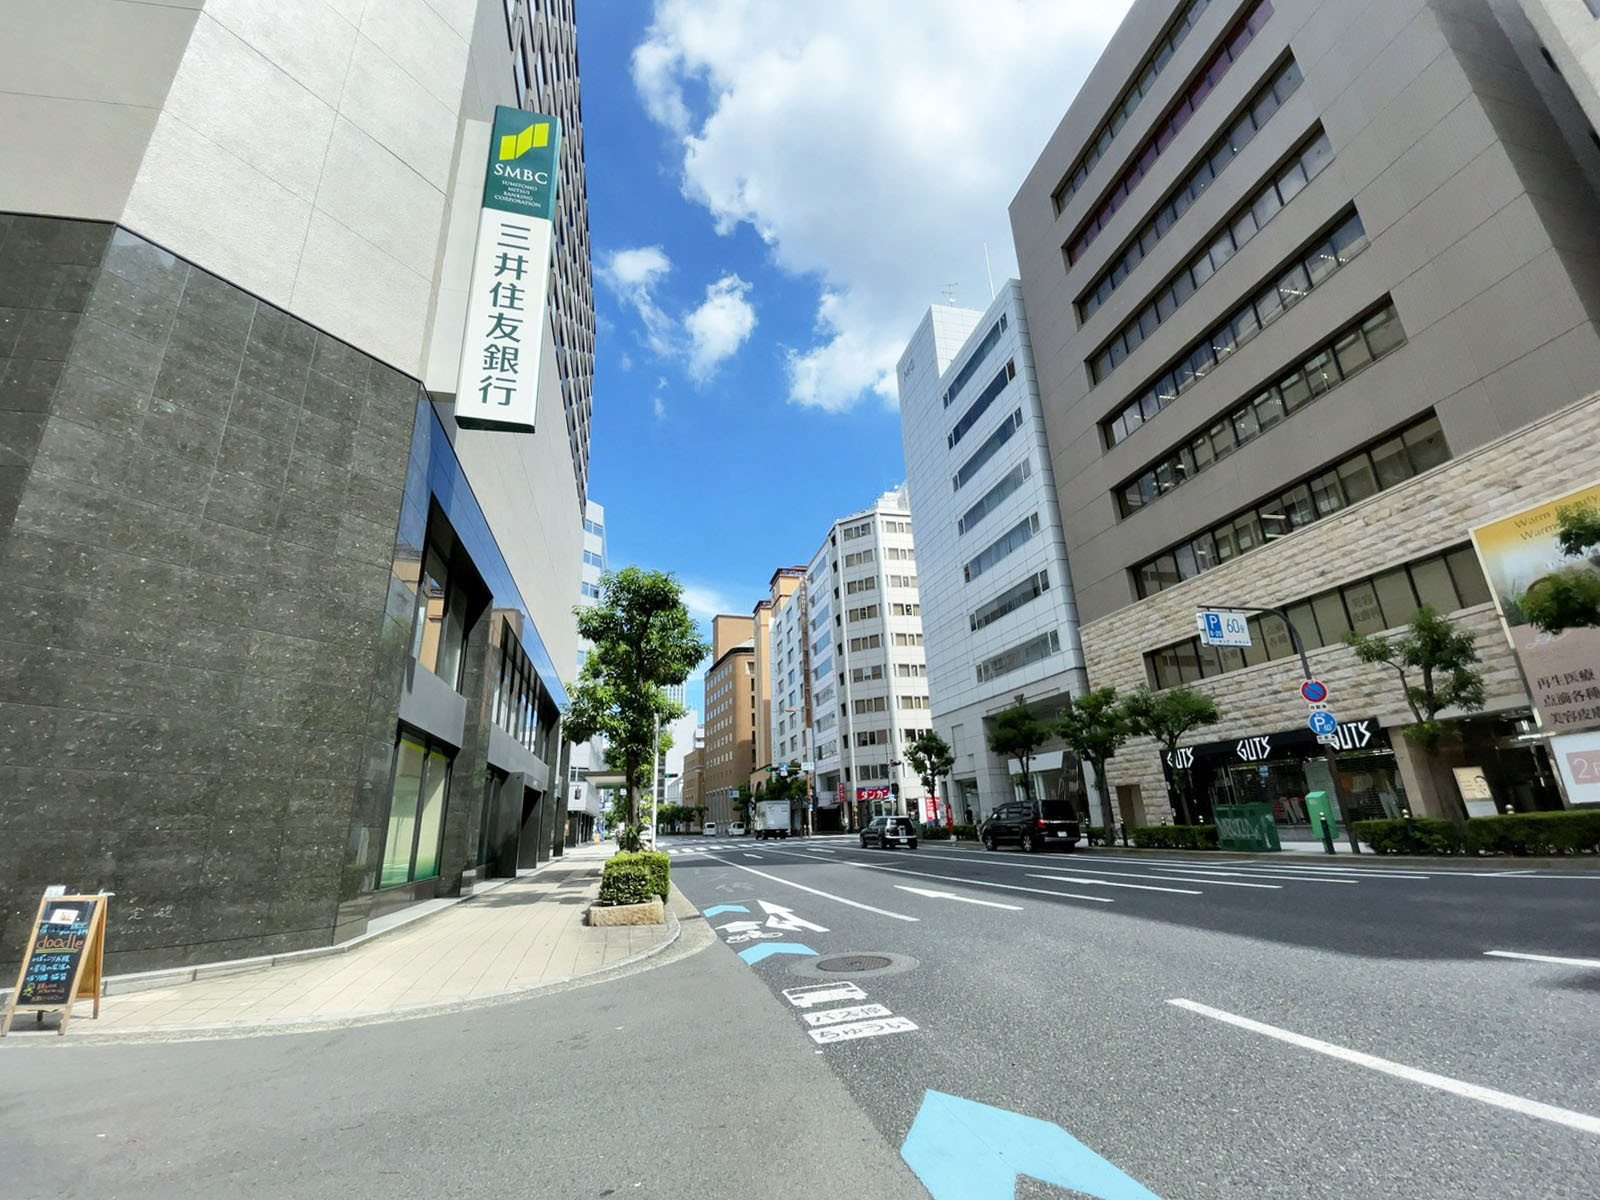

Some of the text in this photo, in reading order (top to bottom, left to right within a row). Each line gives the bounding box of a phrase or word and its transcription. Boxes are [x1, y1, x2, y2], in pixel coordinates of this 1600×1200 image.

[493, 163, 548, 185] SMBC
[502, 180, 538, 191] SUMITOMO
[507, 187, 531, 195] MITSUI
[494, 195, 541, 208] CORPORATION
[503, 191, 534, 201] BANKING
[478, 223, 531, 407] 三井住友銀行
[1513, 512, 1552, 528] Warm
[1209, 615, 1218, 630] P
[1537, 667, 1596, 690] 再生医療
[1313, 716, 1325, 732] P
[1236, 735, 1272, 761] GUTS
[36, 933, 84, 950] doodle
[815, 1006, 881, 1022] バス停
[815, 1021, 911, 1040] ちゅうい
